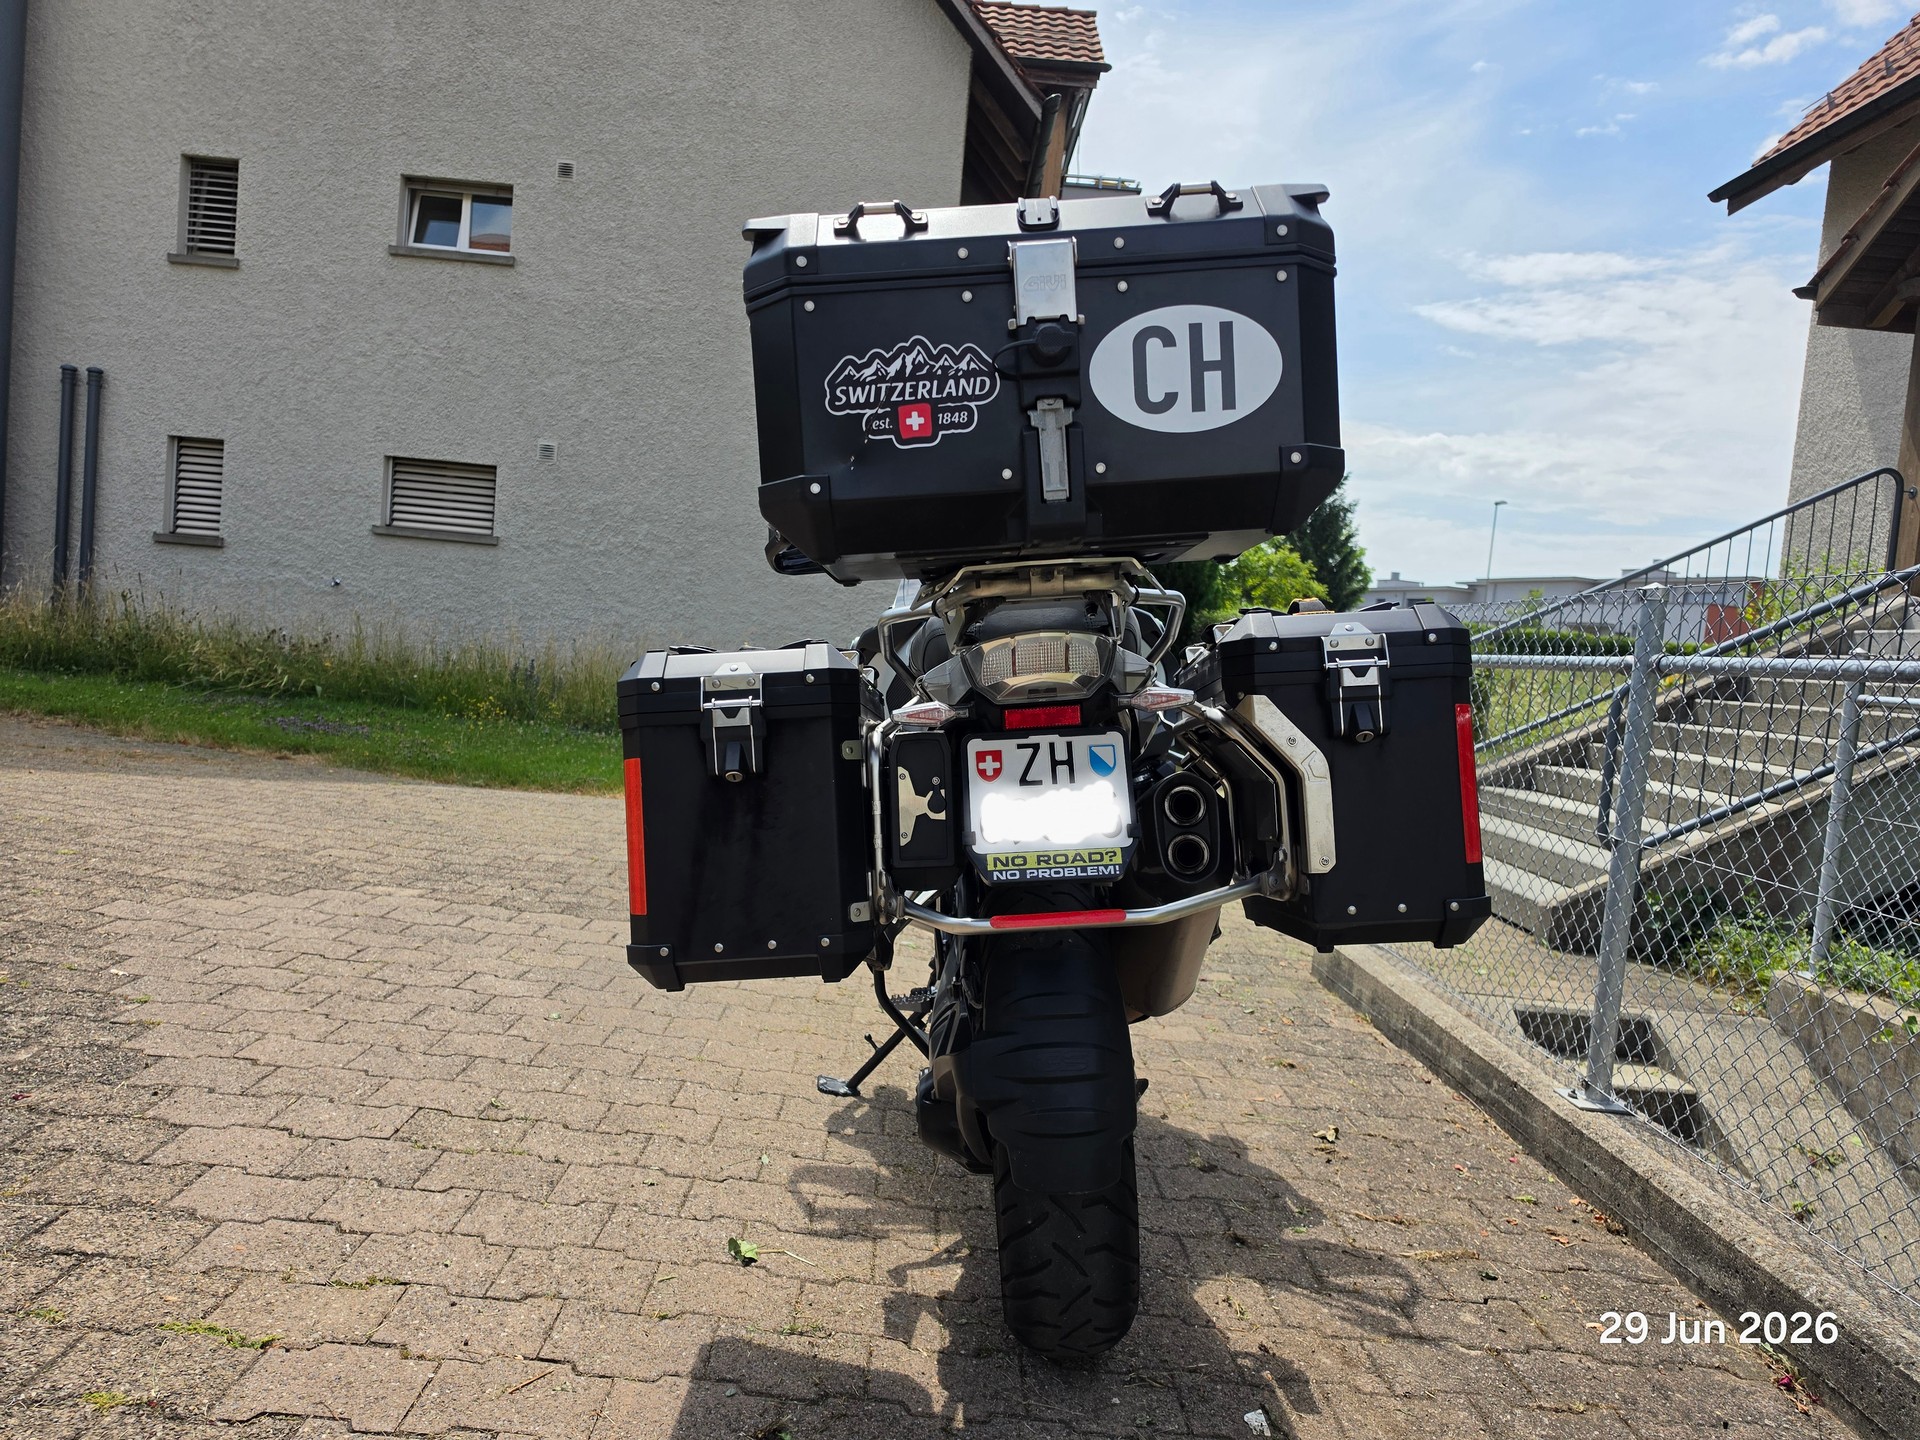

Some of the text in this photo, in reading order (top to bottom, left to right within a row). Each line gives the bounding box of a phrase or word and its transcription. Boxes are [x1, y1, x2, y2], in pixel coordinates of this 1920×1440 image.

[1023, 274, 1067, 292] GIVI
[1132, 320, 1237, 415] CH
[834, 376, 991, 405] SWITZERLAND
[871, 411, 968, 430] est. 1848
[1016, 741, 1076, 786] ZH
[992, 850, 1118, 869] NO ROAD?
[993, 865, 1120, 881] NO PROBLEM!
